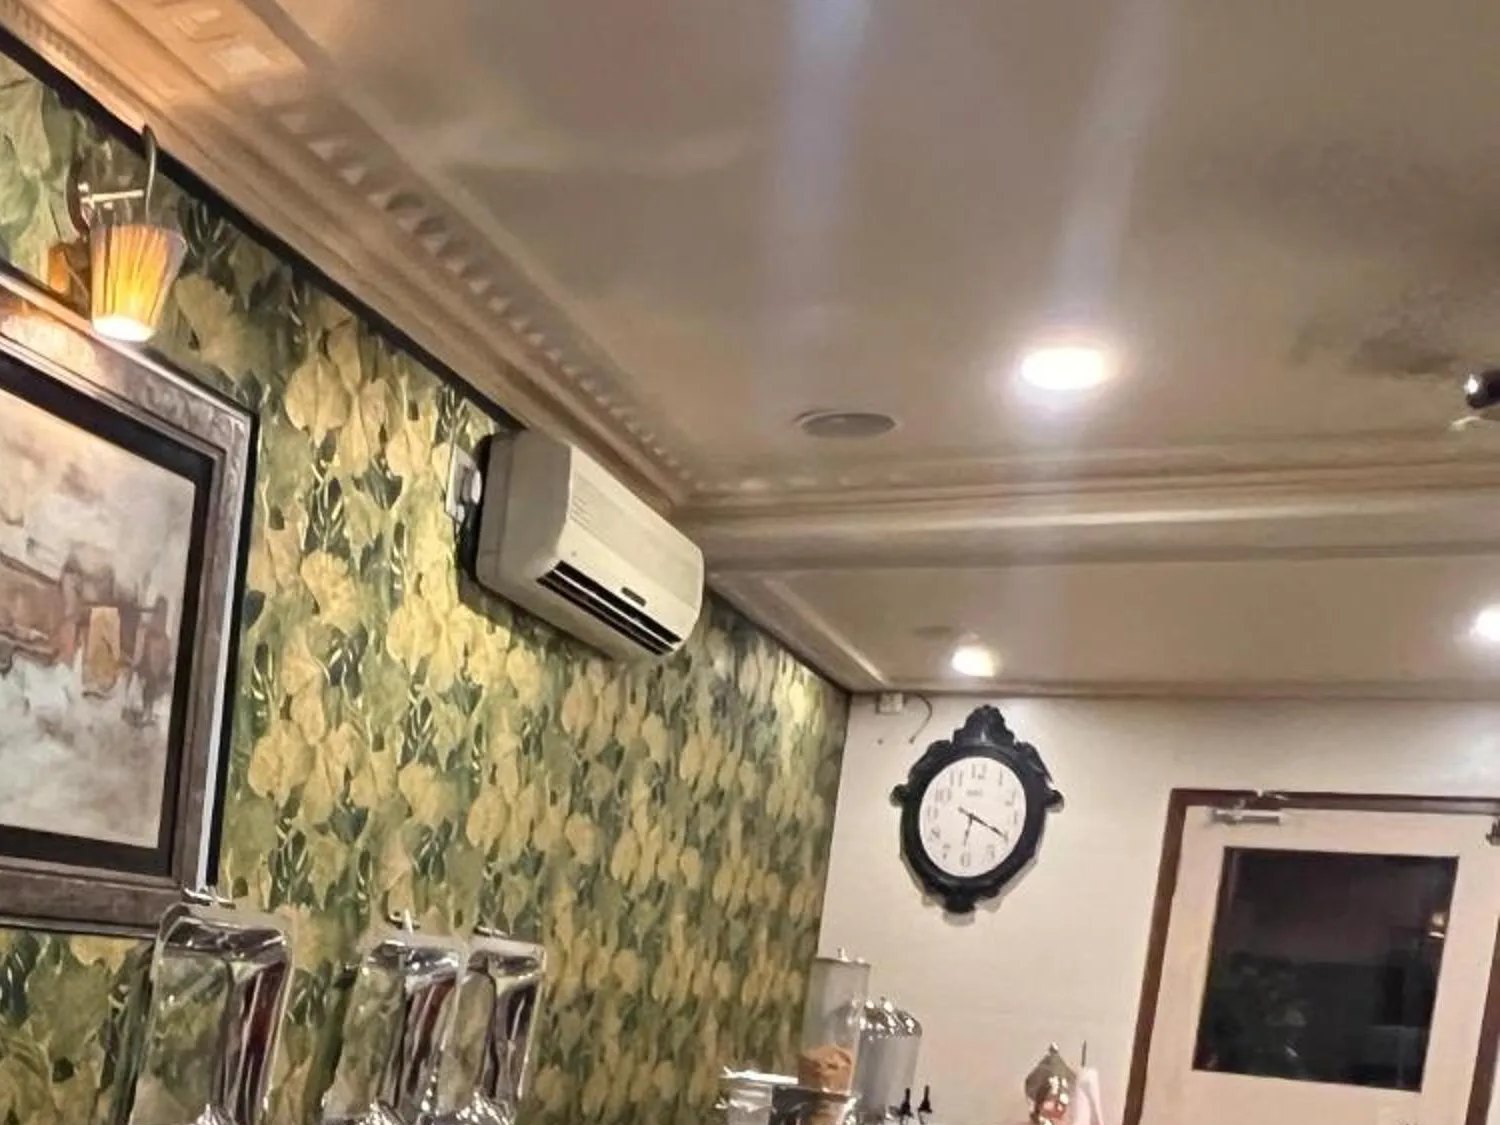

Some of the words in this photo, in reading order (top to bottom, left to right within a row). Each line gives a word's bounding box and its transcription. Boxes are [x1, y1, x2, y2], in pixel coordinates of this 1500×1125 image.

[950, 770, 964, 787] 11
[971, 763, 987, 780] 12
[998, 767, 1004, 787] 1
